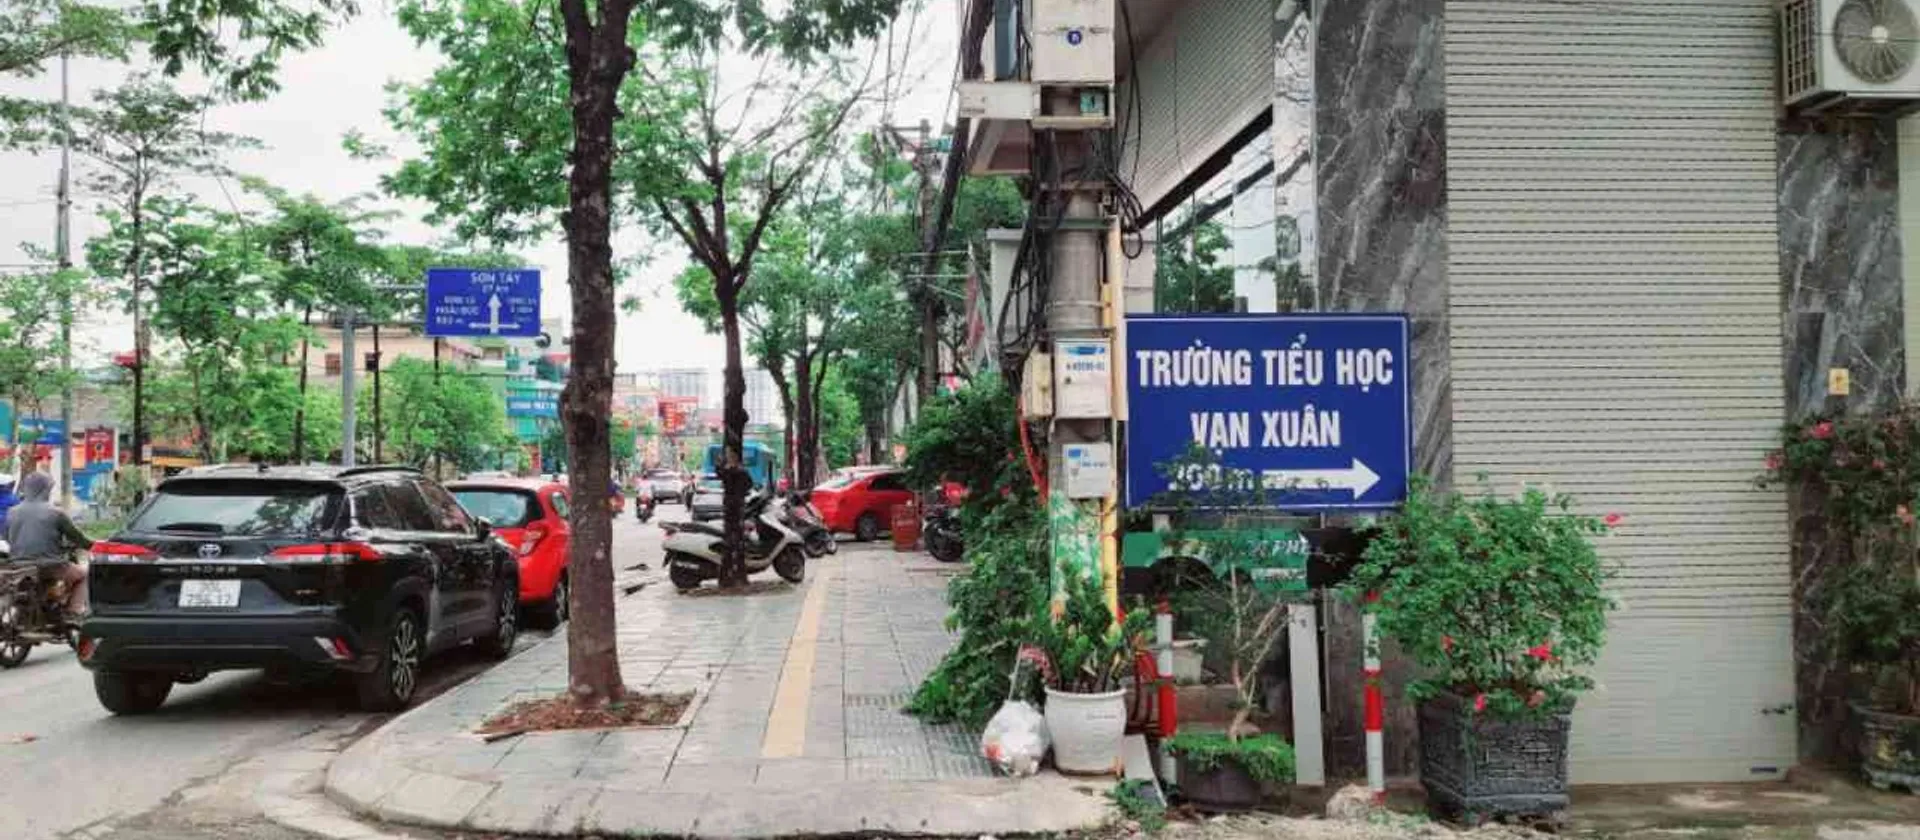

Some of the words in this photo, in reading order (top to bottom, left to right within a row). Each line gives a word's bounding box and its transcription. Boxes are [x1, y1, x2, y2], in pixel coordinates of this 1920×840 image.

[1136, 339, 1252, 387] TRƯỜNG
[1261, 333, 1324, 386] TIỂU
[1335, 347, 1394, 392] HỌC
[1190, 411, 1250, 457] VẠN
[1261, 403, 1341, 448] XUÂN
